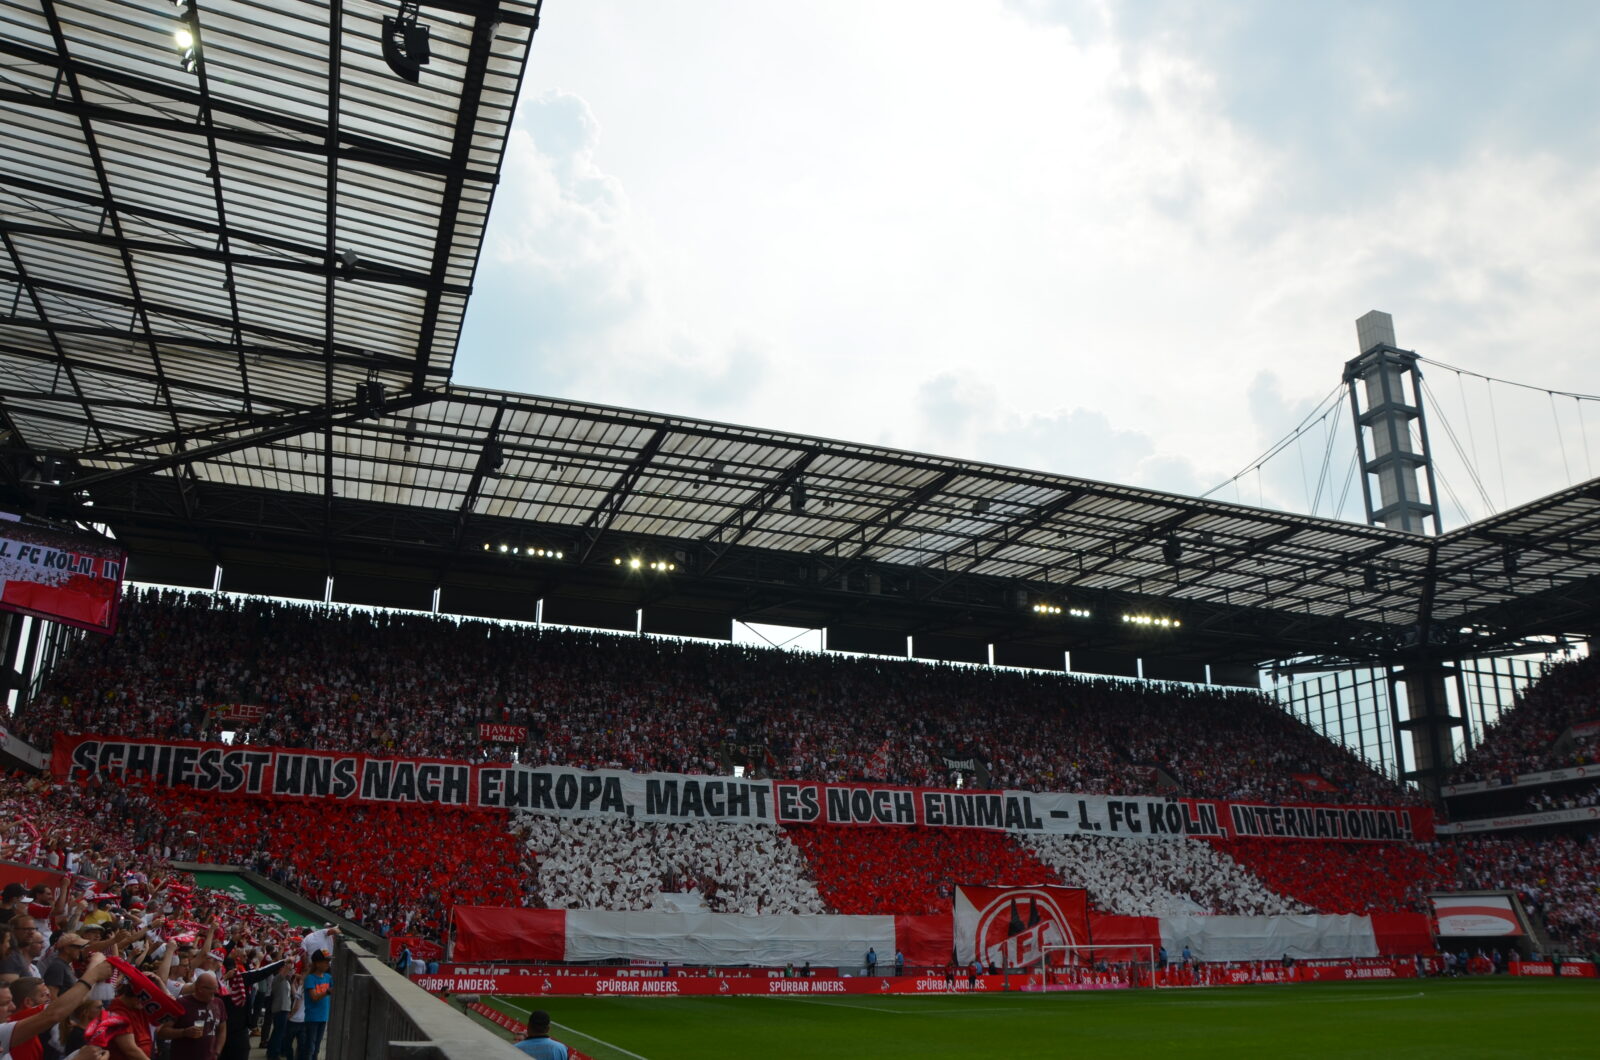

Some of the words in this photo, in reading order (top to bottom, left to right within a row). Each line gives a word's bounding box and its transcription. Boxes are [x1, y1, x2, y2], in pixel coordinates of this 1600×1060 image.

[17, 545, 41, 564] FC
[43, 549, 97, 578] KÖLN,
[480, 724, 526, 740] HAWKS
[71, 741, 272, 793] SCHIESST
[273, 753, 357, 799] UNS
[361, 759, 469, 803] NACH
[479, 769, 635, 816] EUROPA,
[646, 779, 769, 818] MACHT
[778, 784, 820, 821] ES
[827, 788, 915, 824] NOCH
[922, 792, 1042, 829] EINMAL
[1108, 801, 1141, 833] FC
[1148, 797, 1226, 839] KÖLN,
[1230, 804, 1413, 840] INTERNATIONAL!
[457, 979, 498, 991] ANDERS.
[596, 979, 639, 992] SPÜRBAR
[642, 980, 680, 992] ANDERS.
[769, 980, 809, 992] SPÜRBAR
[811, 981, 846, 992] ANDERS.
